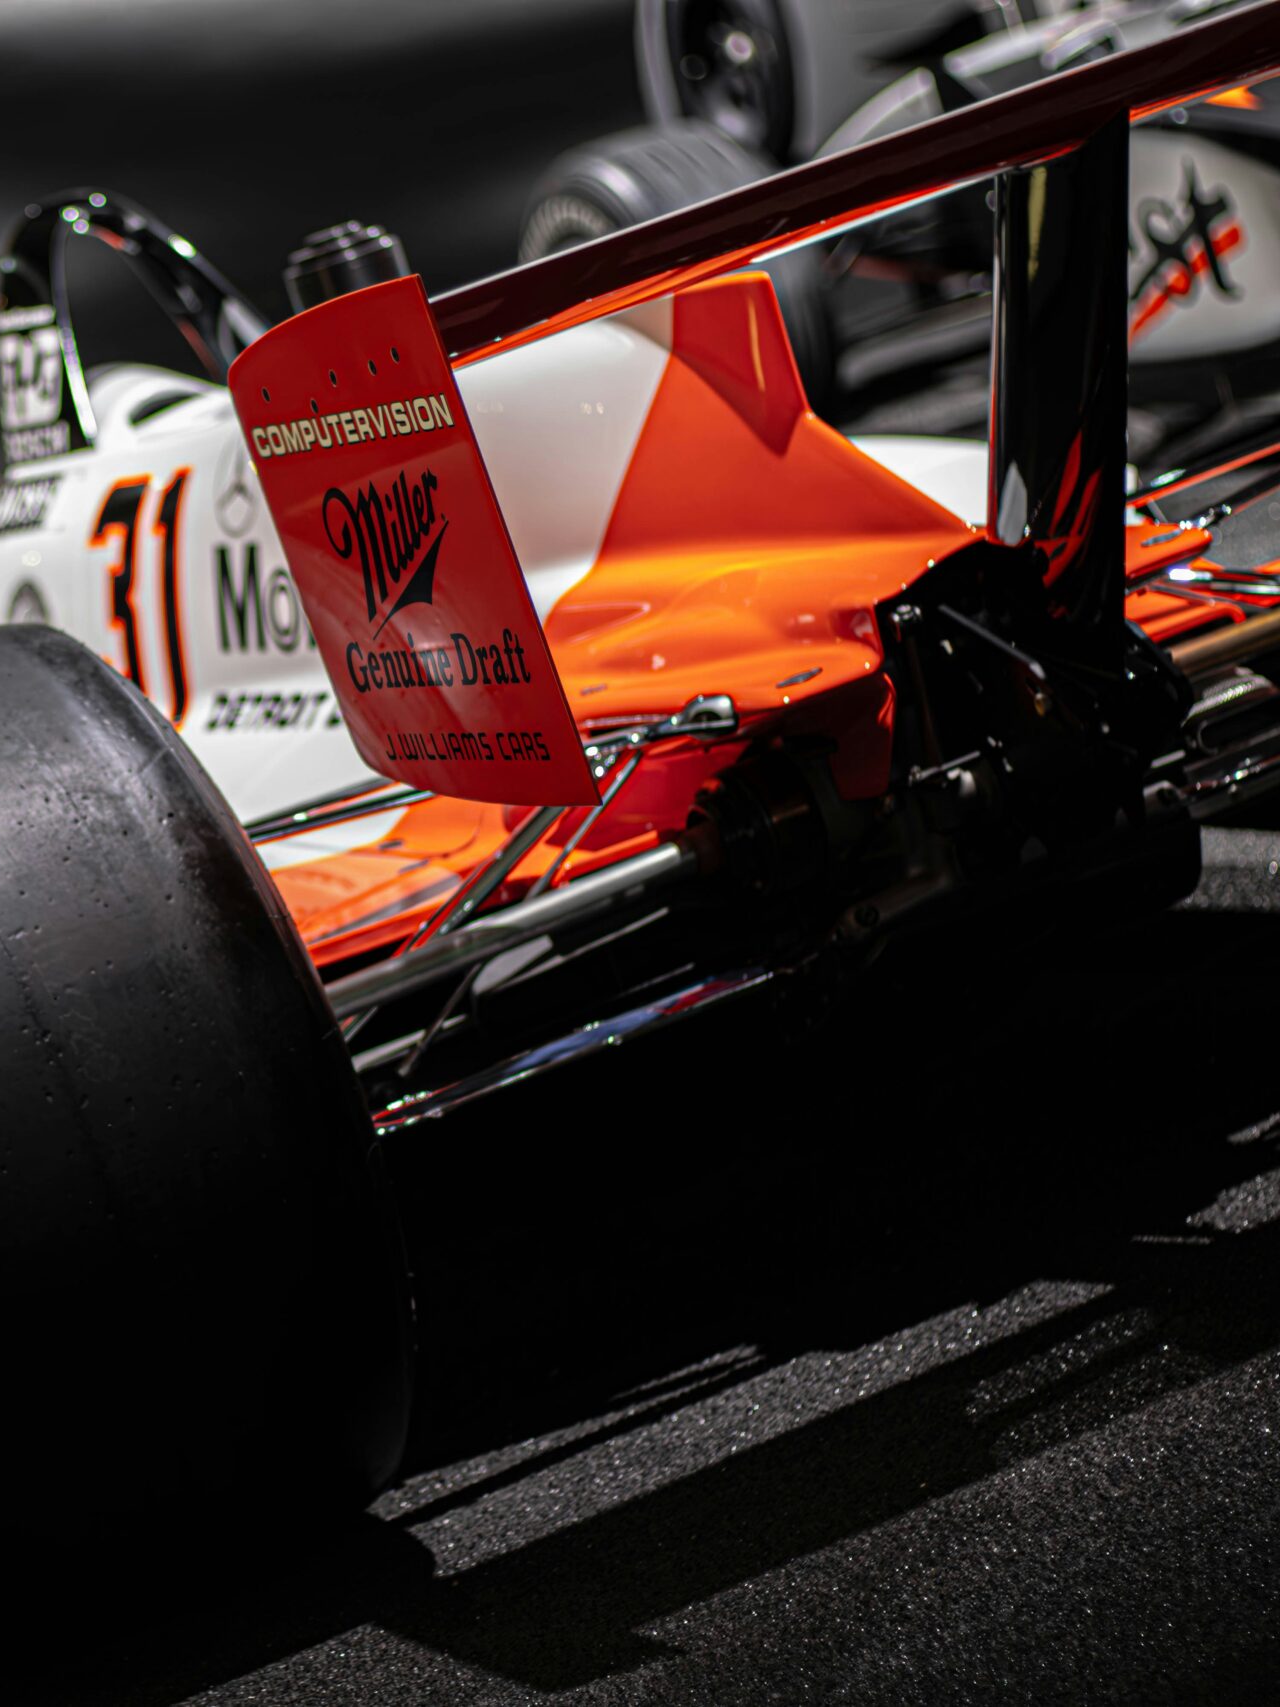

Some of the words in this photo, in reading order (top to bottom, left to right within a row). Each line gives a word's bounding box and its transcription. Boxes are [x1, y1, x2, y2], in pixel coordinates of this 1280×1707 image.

[252, 394, 455, 458] COMPUTERVISION
[322, 468, 439, 623] Miller
[88, 466, 191, 732] 31
[215, 542, 317, 654] Mo
[346, 632, 453, 693] Genuine
[450, 628, 531, 686] Draft
[207, 691, 328, 729] DETROIT
[386, 732, 495, 761] J.WILLIAMS
[495, 732, 551, 761] CARS
